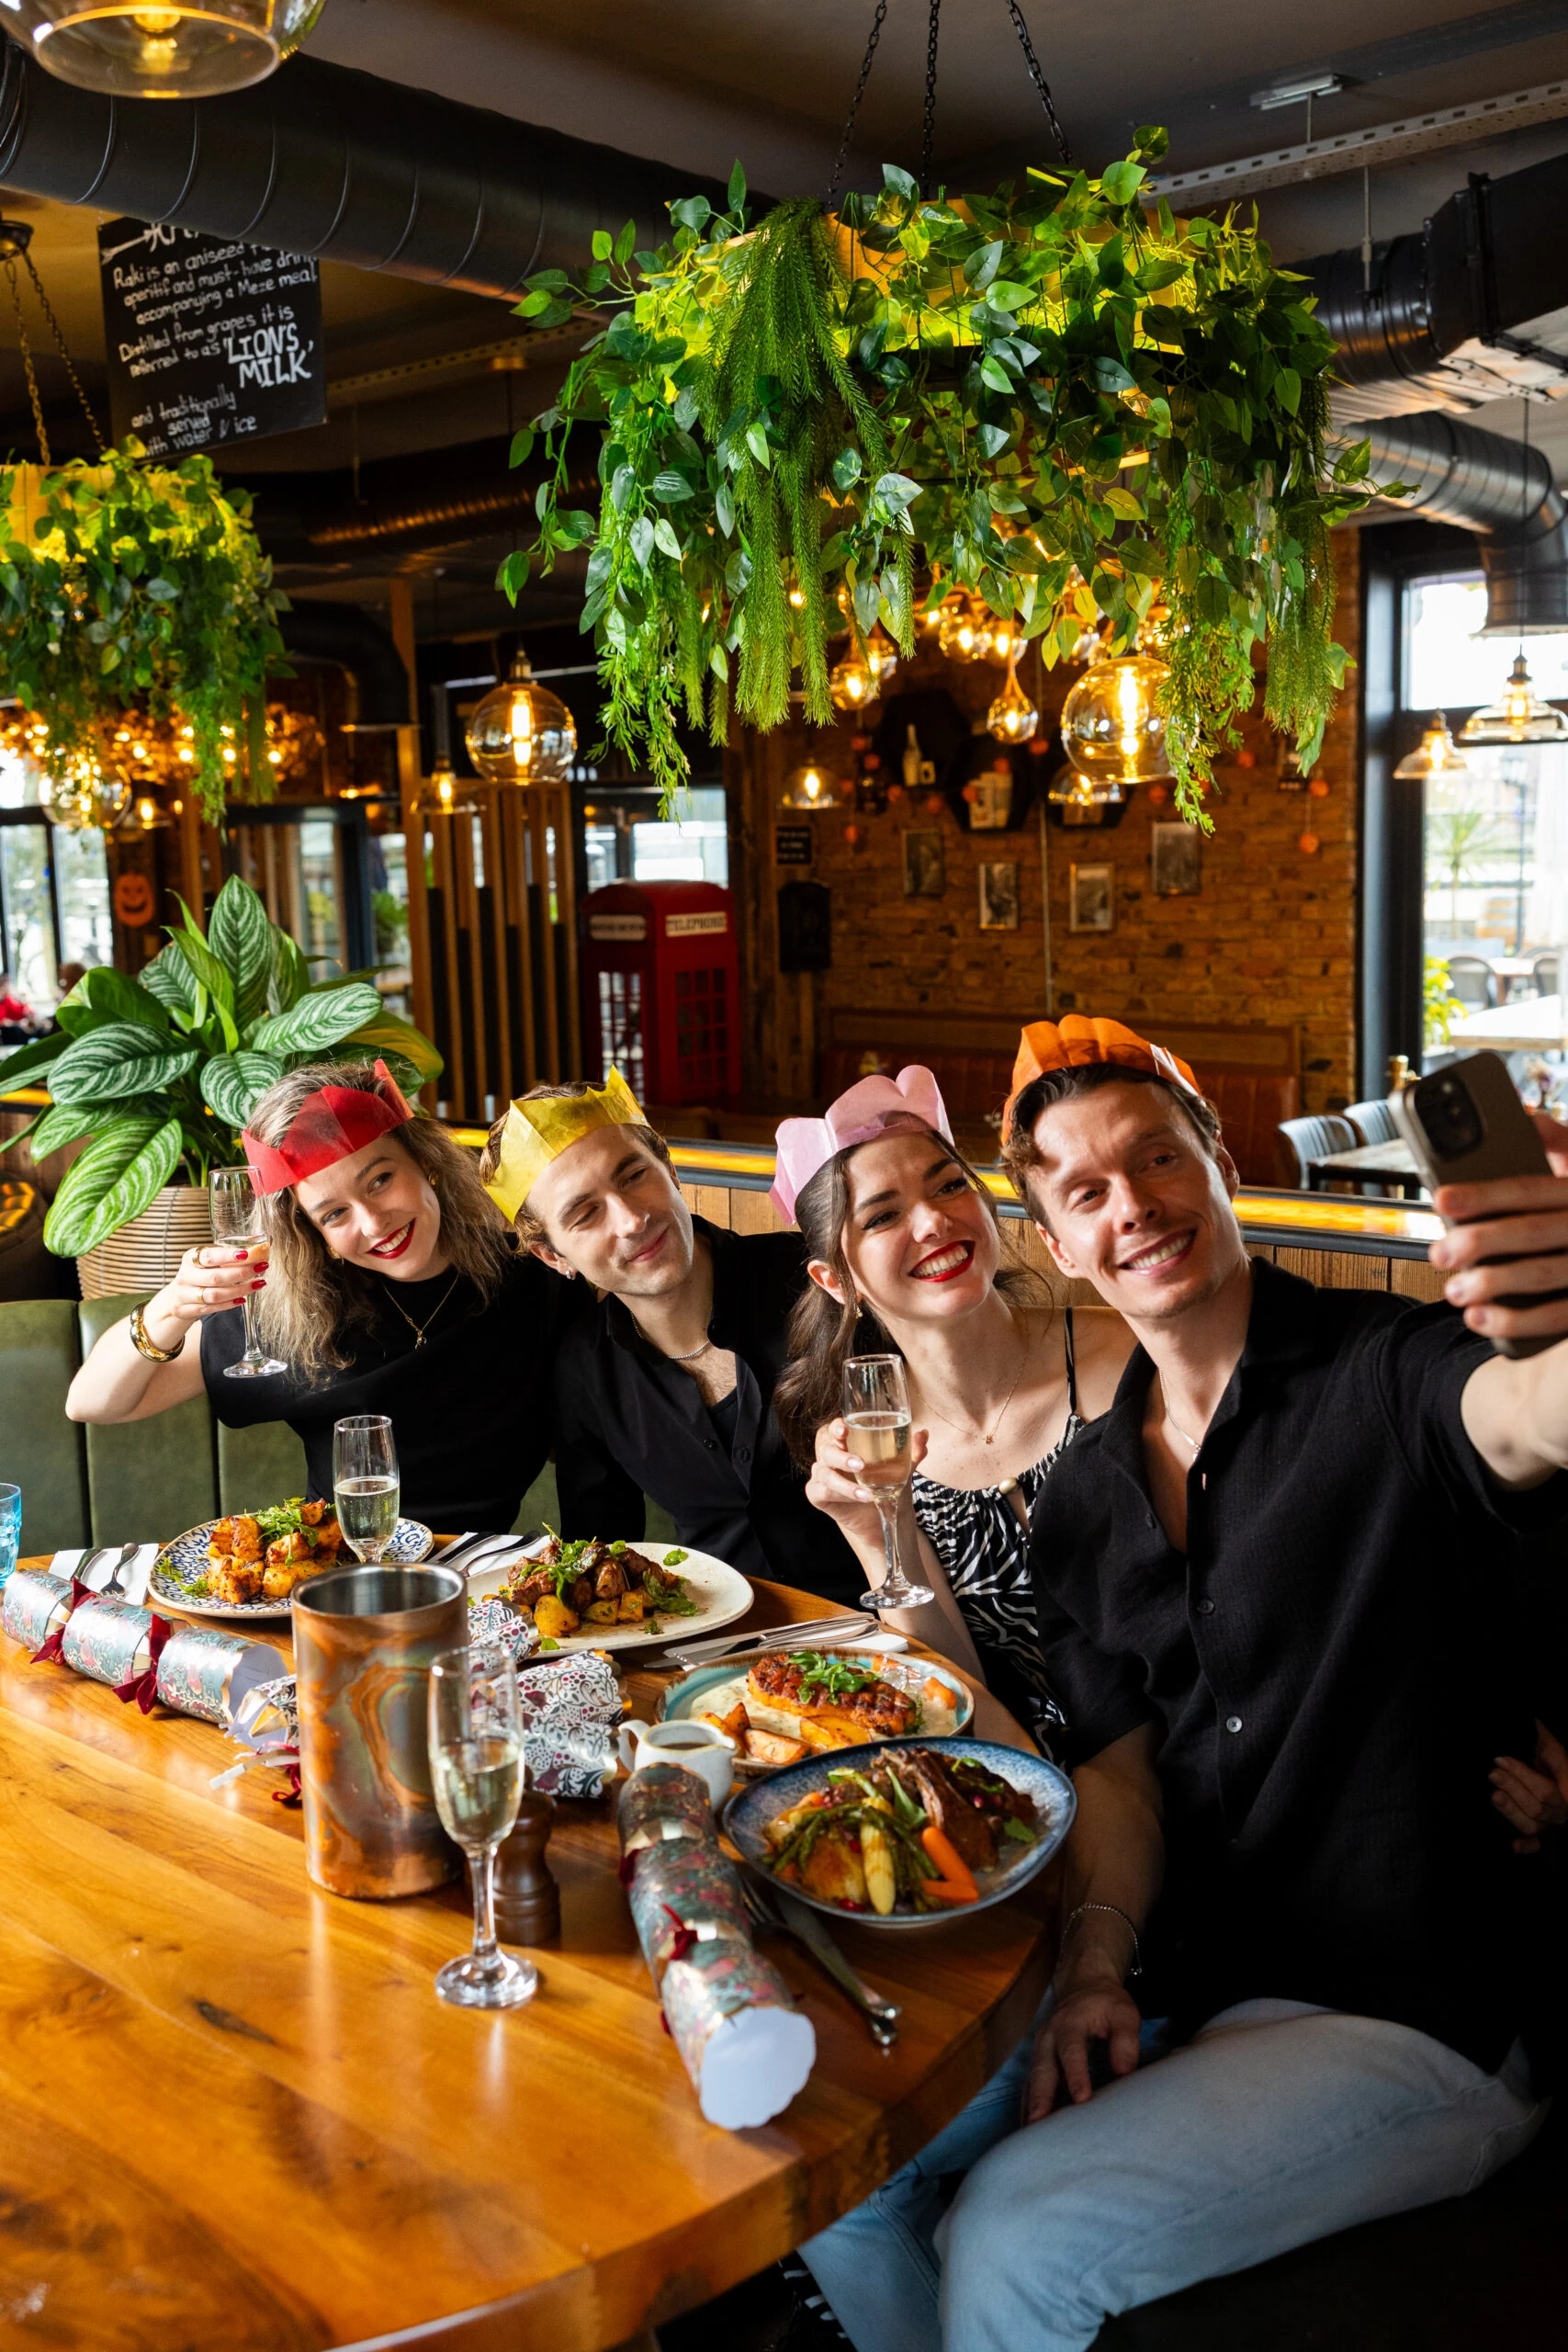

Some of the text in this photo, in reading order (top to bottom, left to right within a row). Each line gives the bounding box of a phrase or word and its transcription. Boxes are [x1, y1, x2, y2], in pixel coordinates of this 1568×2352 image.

[113, 264, 145, 289] Raki
[146, 266, 161, 278] is
[164, 260, 180, 275] an
[185, 242, 245, 270] aniseed
[124, 279, 172, 311] aperitif
[173, 277, 195, 295] and
[136, 292, 222, 326] accompanying
[225, 288, 233, 299] a
[238, 277, 276, 297] Meze
[118, 303, 295, 363] Distilled from grapes it is
[130, 349, 179, 379] referred
[184, 349, 198, 362] to
[201, 344, 221, 356] as
[131, 383, 237, 428] and traditionally
[167, 413, 211, 436] served
[174, 426, 213, 449] water
[234, 415, 258, 434] ice
